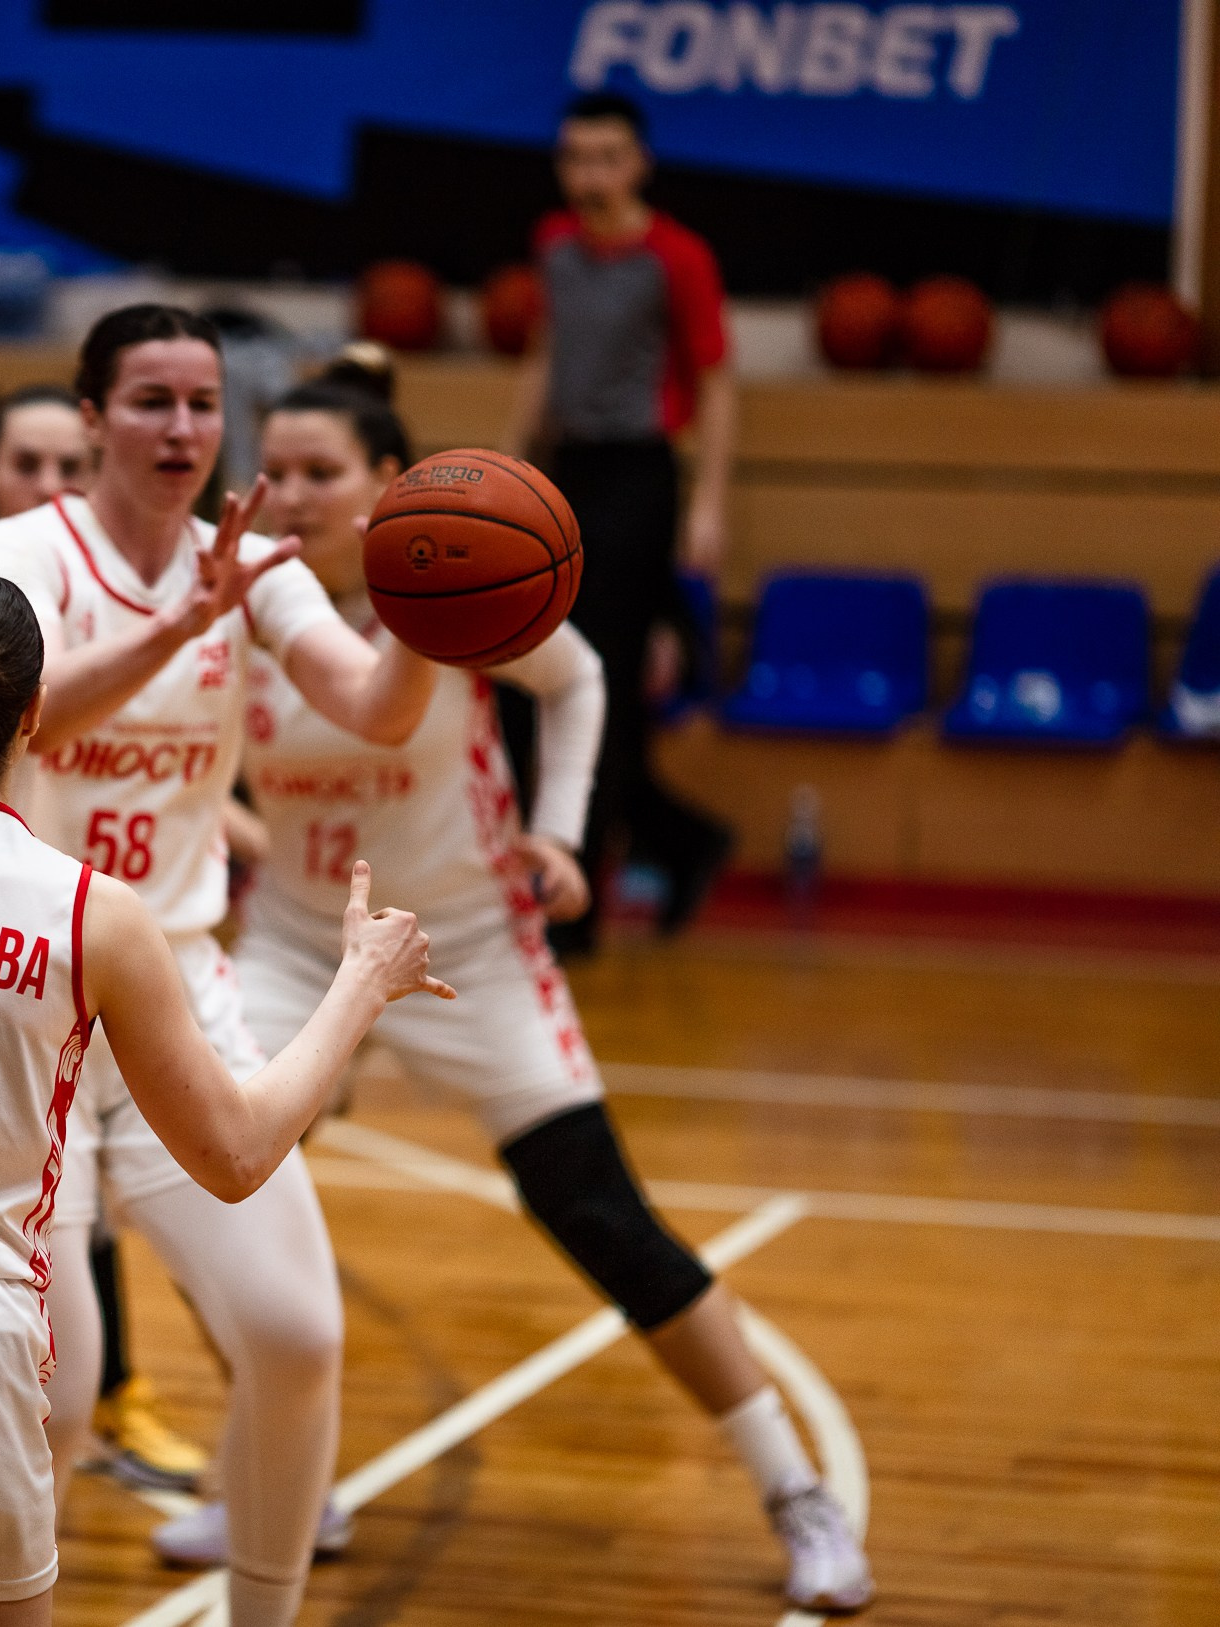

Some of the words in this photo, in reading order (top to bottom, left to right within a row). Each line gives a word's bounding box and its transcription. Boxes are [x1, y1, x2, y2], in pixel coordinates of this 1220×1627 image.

[569, 1, 1019, 99] FONBET
[84, 810, 156, 882] 58
[306, 820, 358, 882] 12
